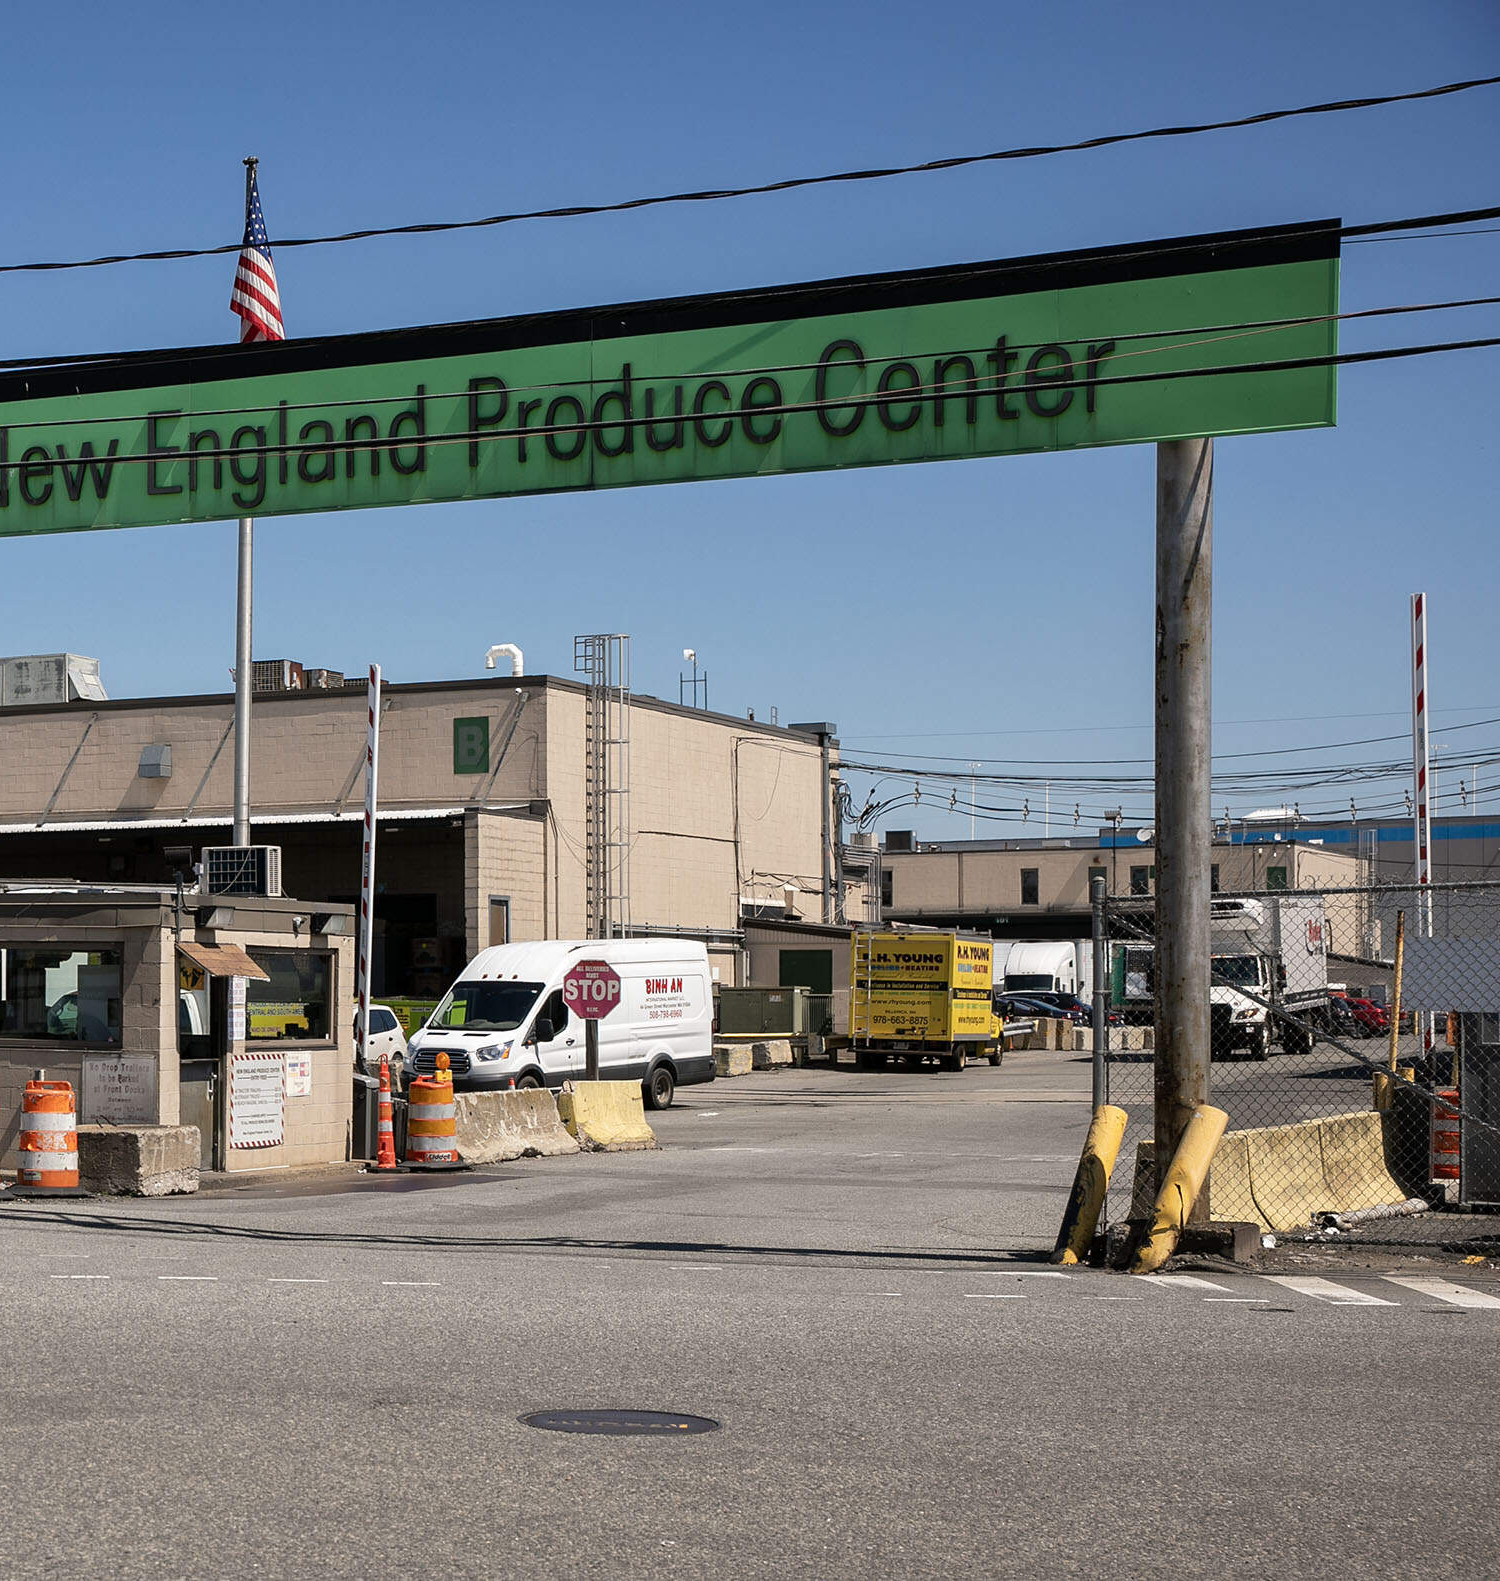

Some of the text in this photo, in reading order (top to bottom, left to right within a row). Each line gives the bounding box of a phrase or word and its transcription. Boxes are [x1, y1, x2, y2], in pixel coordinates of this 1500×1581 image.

[146, 384, 427, 509] England
[468, 362, 783, 467] Produce
[815, 334, 1116, 437] Center
[459, 726, 484, 768] B
[892, 953, 943, 964] YOUNG
[970, 946, 990, 962] YOUNG
[565, 979, 620, 1001] STOP
[645, 977, 683, 995] BINH AN
[873, 1016, 929, 1025] 978-663-8875
[102, 1063, 119, 1072] Drop
